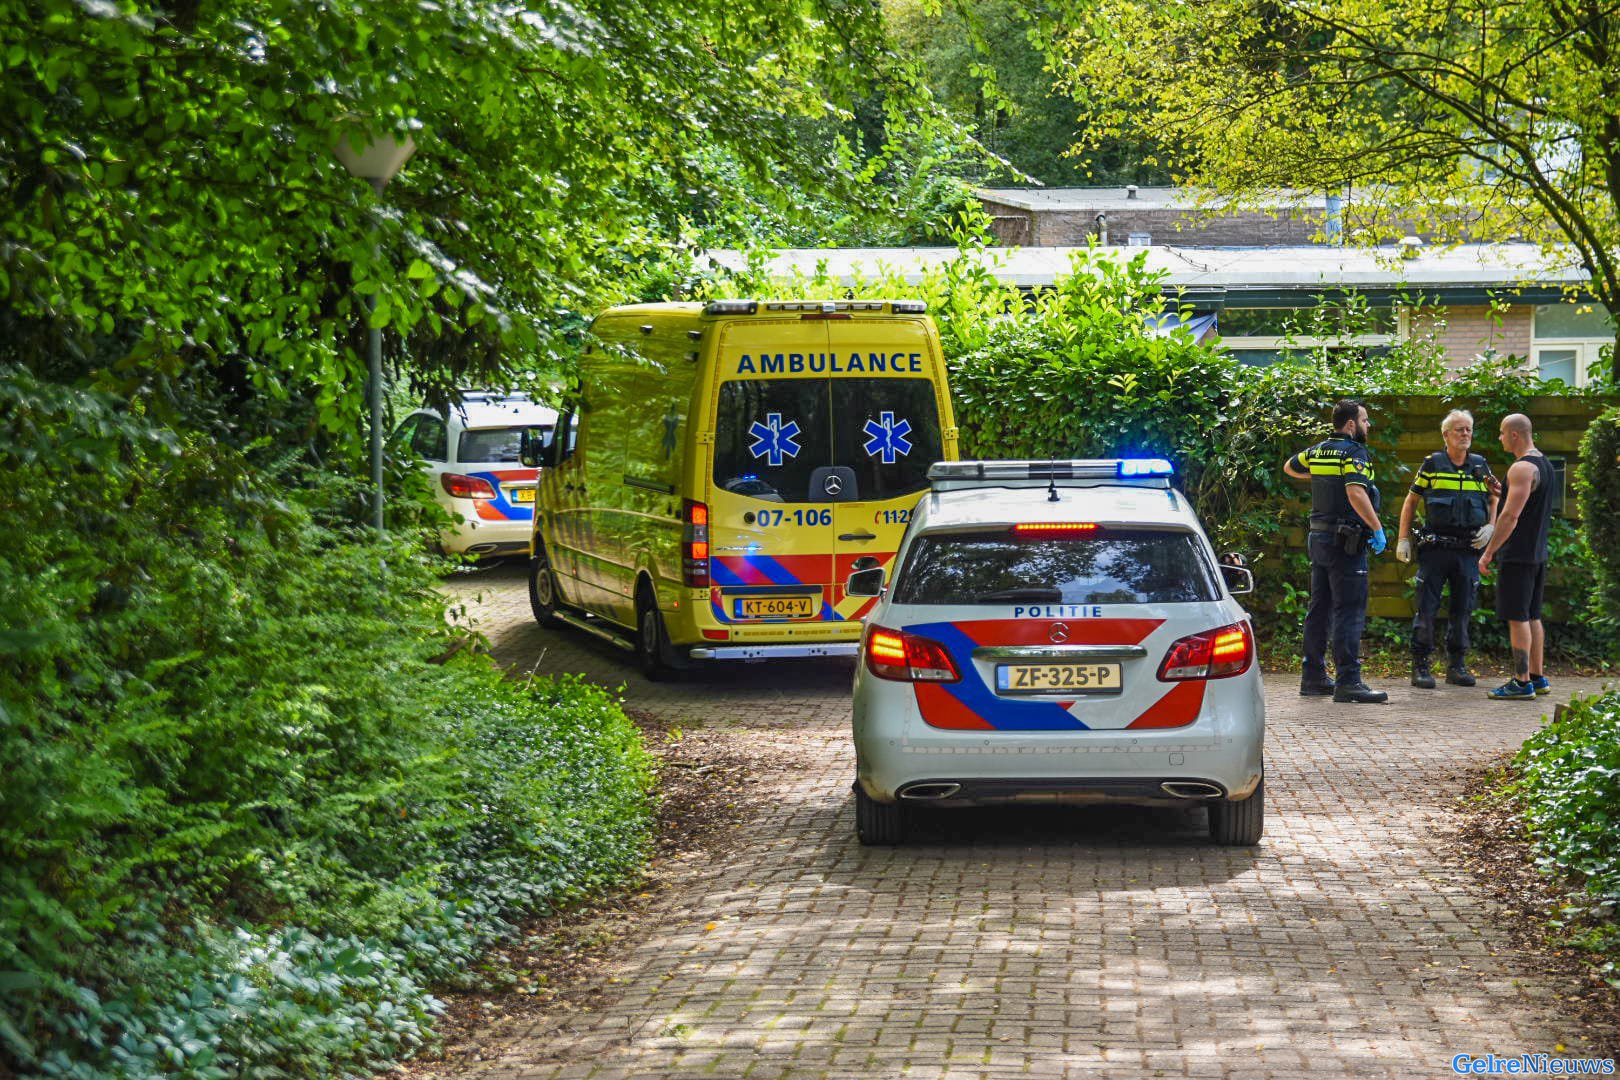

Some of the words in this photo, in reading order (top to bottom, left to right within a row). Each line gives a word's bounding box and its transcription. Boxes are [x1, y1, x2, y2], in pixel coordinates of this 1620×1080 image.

[737, 352, 923, 374] AMBULANCE
[757, 509, 832, 527] 07-106
[746, 600, 807, 613] KT-604-V
[1014, 605, 1103, 618] POLITIE
[1016, 666, 1111, 687] ZF-325-P
